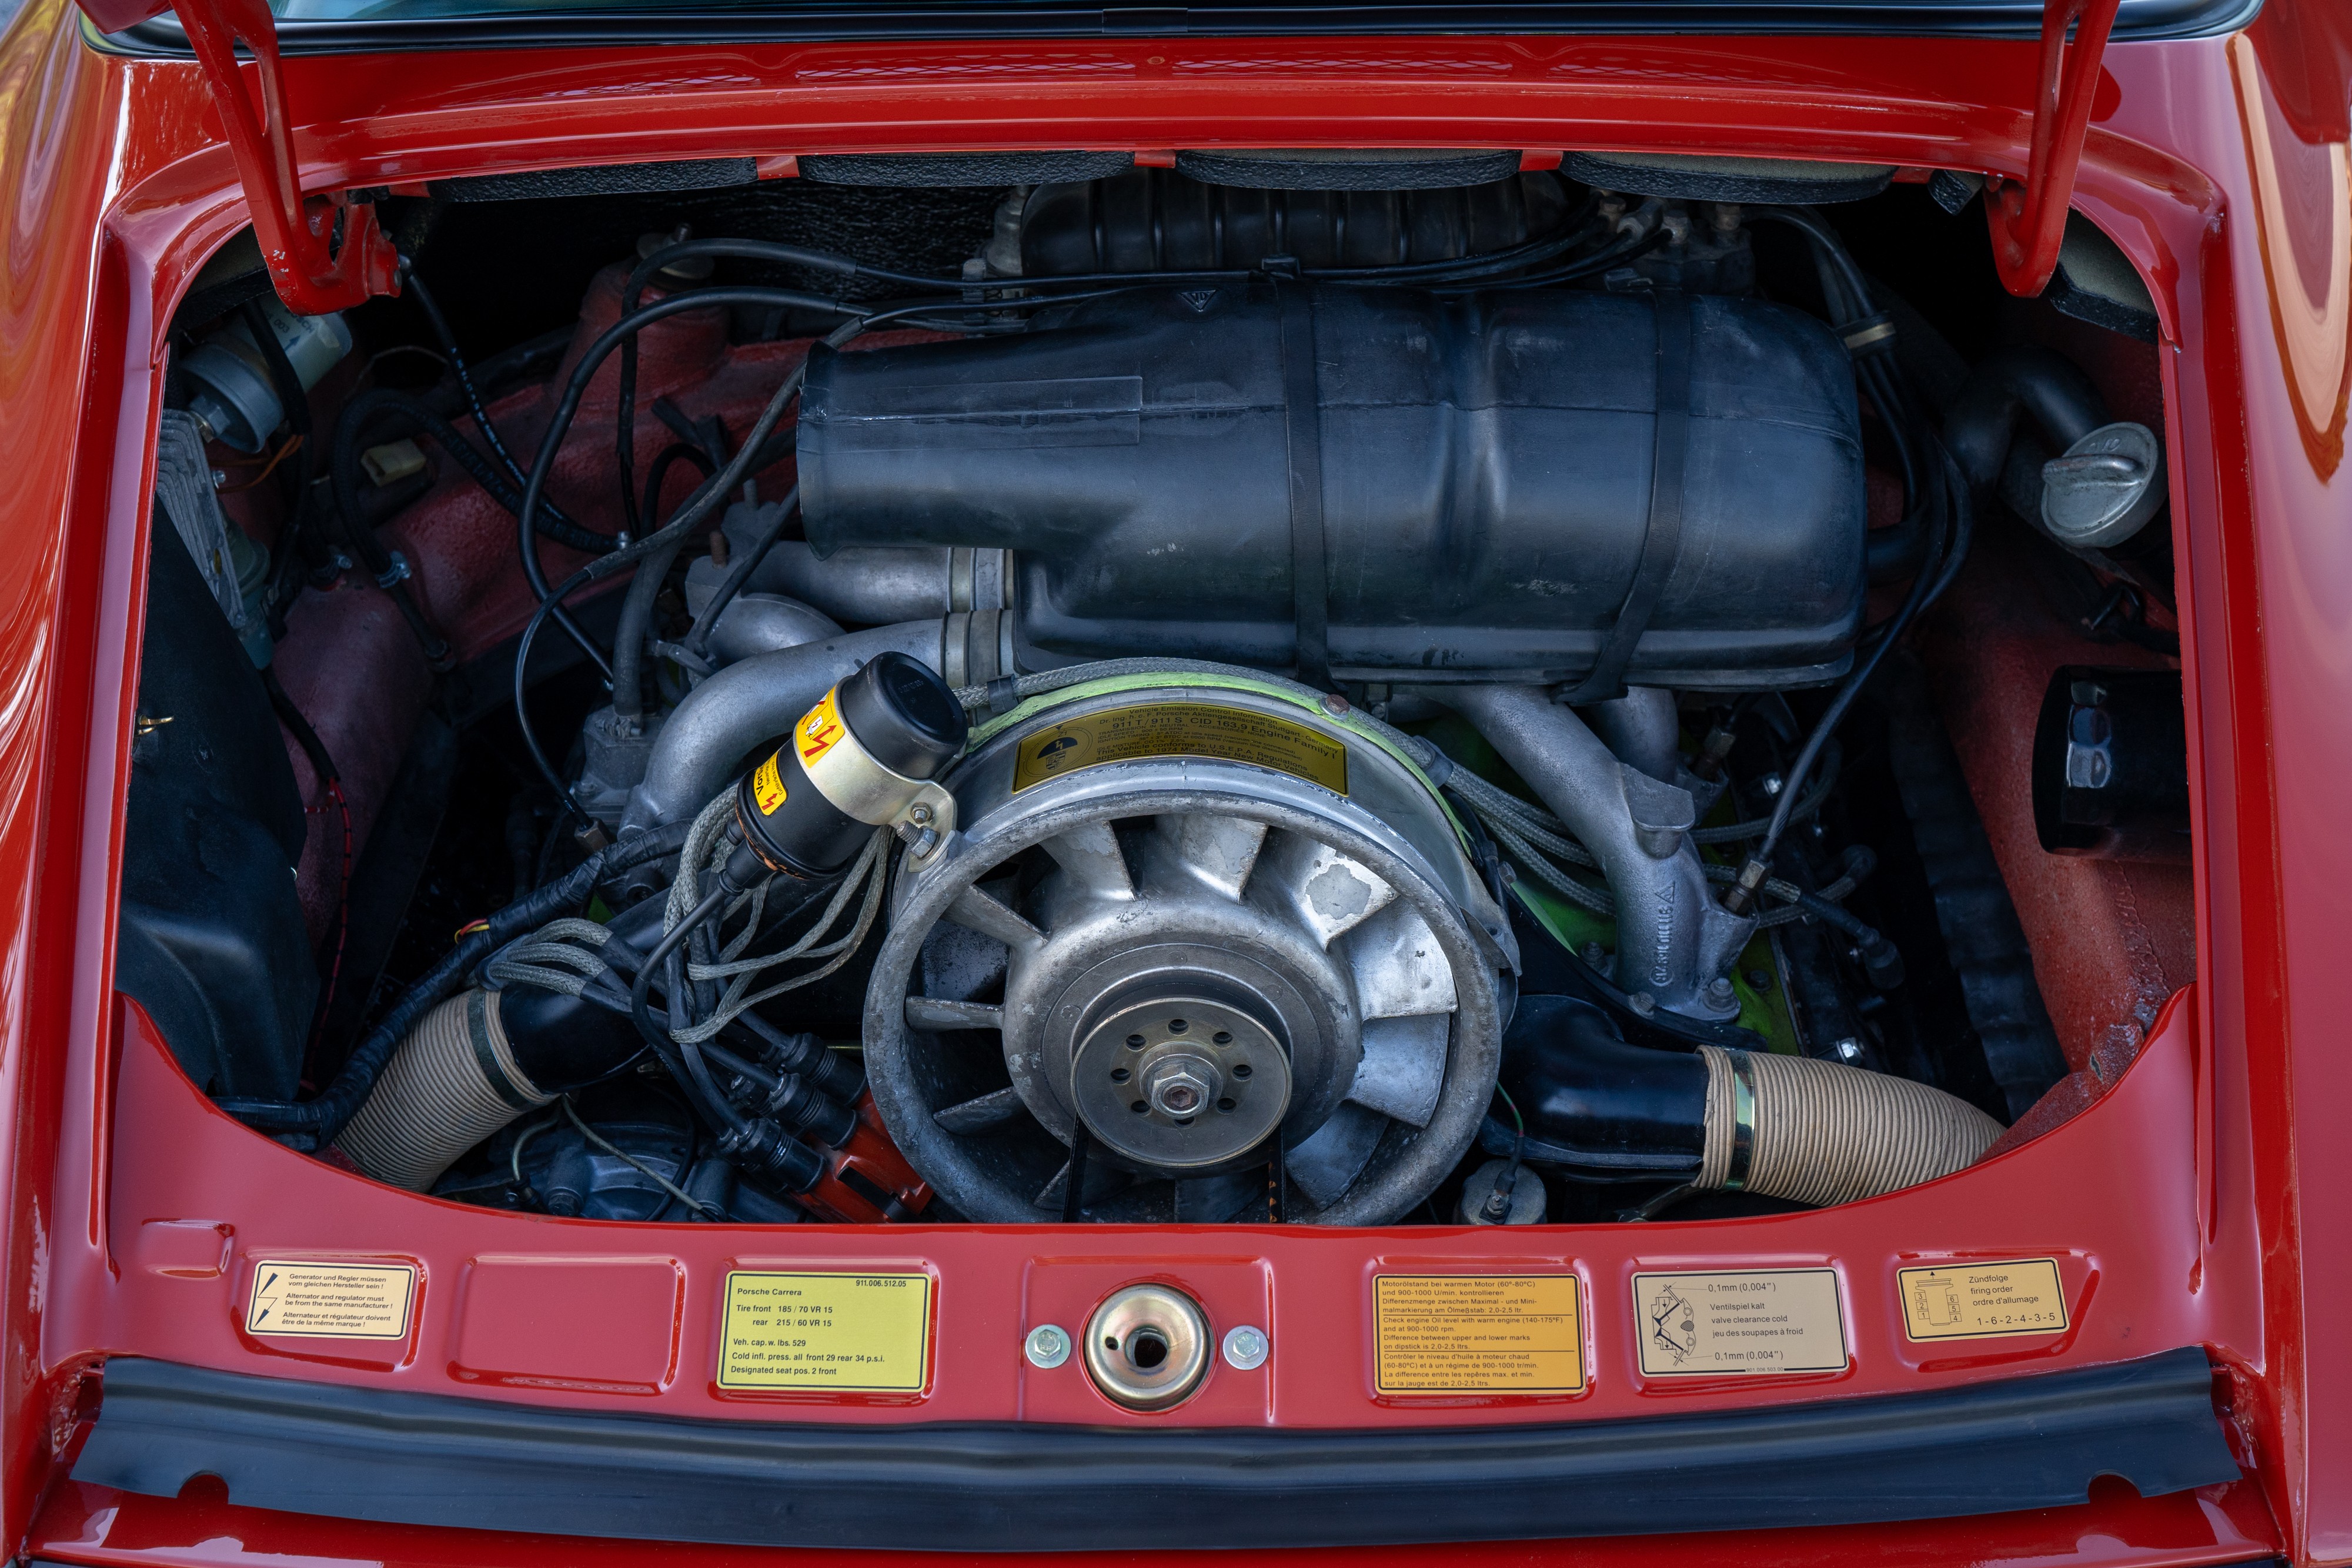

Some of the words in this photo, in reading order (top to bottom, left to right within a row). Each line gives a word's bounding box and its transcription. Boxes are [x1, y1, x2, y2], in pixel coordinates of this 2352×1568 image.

[274, 319, 289, 333] 003
[1201, 707, 1230, 715] Control
[1233, 711, 1277, 724] Information
[1217, 720, 1248, 730] 163,9
[1251, 726, 1290, 741] Engine
[1294, 737, 1329, 757] Family
[1969, 1275, 2009, 1283] Zündfolge
[1708, 1284, 1737, 1292] 0,1mm
[1996, 1296, 2039, 1305] d'allumage
[1710, 1303, 1749, 1311] Ventilspiel
[1991, 1316, 1997, 1325] 6
[2005, 1315, 2012, 1324] 2
[2020, 1315, 2026, 1323] 4
[2034, 1313, 2041, 1322] 3
[2049, 1312, 2055, 1321] 5
[1713, 1330, 1724, 1339] jeu
[866, 1355, 884, 1363] p.s.i.
[1715, 1352, 1744, 1360] 0,1mm
[731, 1365, 774, 1375] Designated
